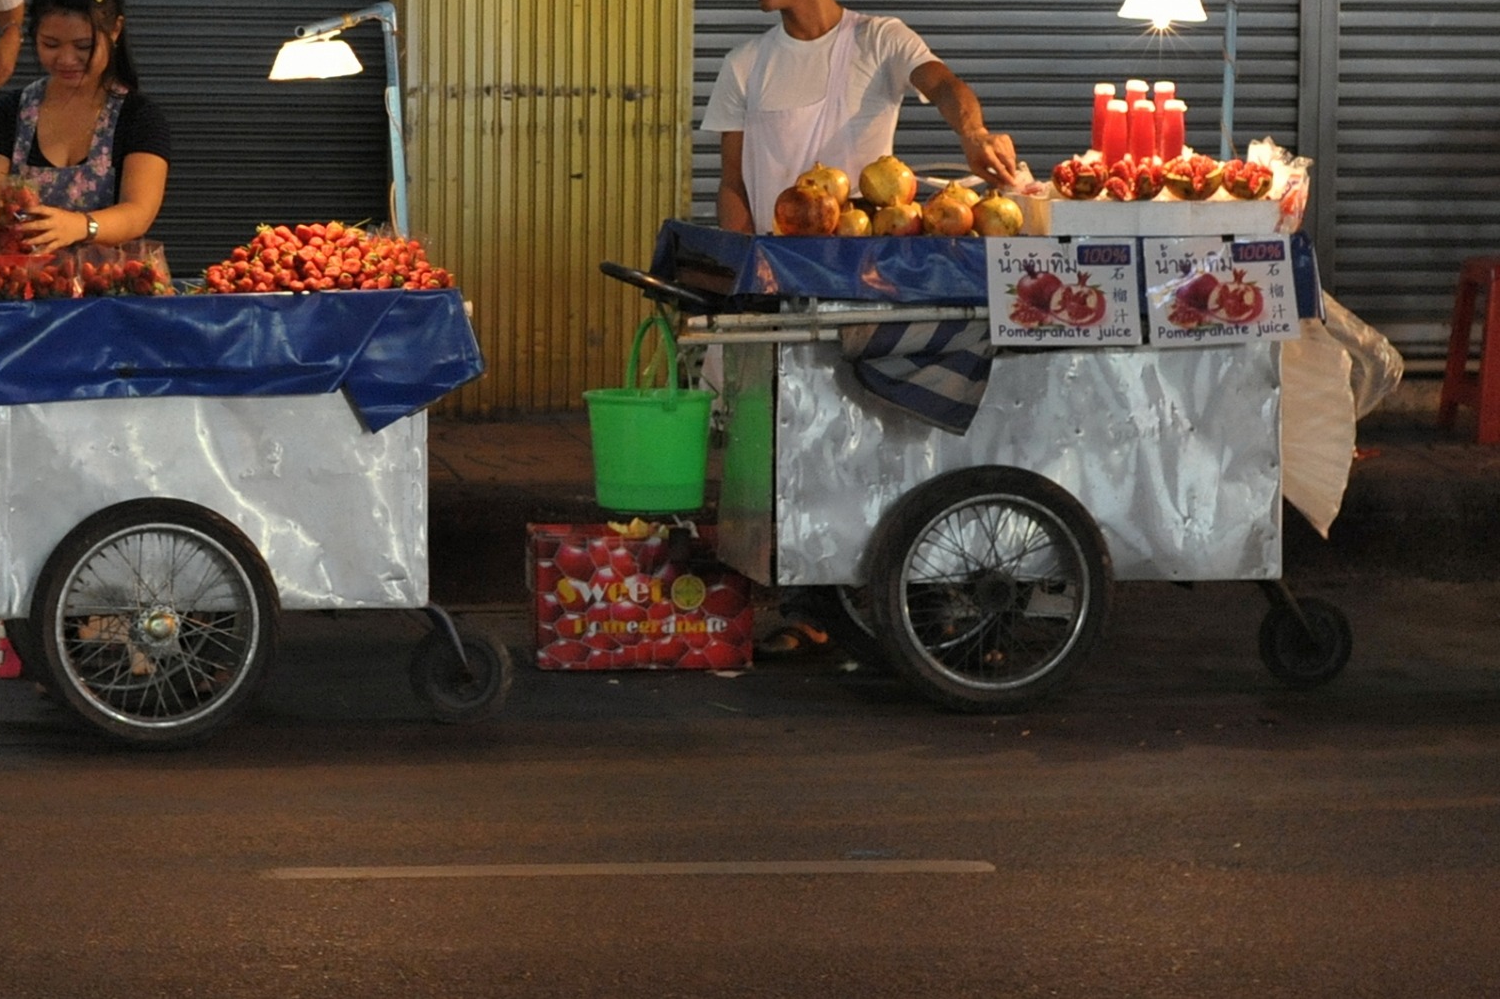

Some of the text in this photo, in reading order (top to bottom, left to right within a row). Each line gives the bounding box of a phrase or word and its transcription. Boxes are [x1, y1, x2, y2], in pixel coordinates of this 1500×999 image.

[1083, 248, 1128, 264] 100%
[1238, 244, 1282, 260] 100%
[998, 324, 1132, 341] Pomegranate juice
[1157, 321, 1291, 341] Pomegranate juice
[556, 578, 664, 603] Sweet
